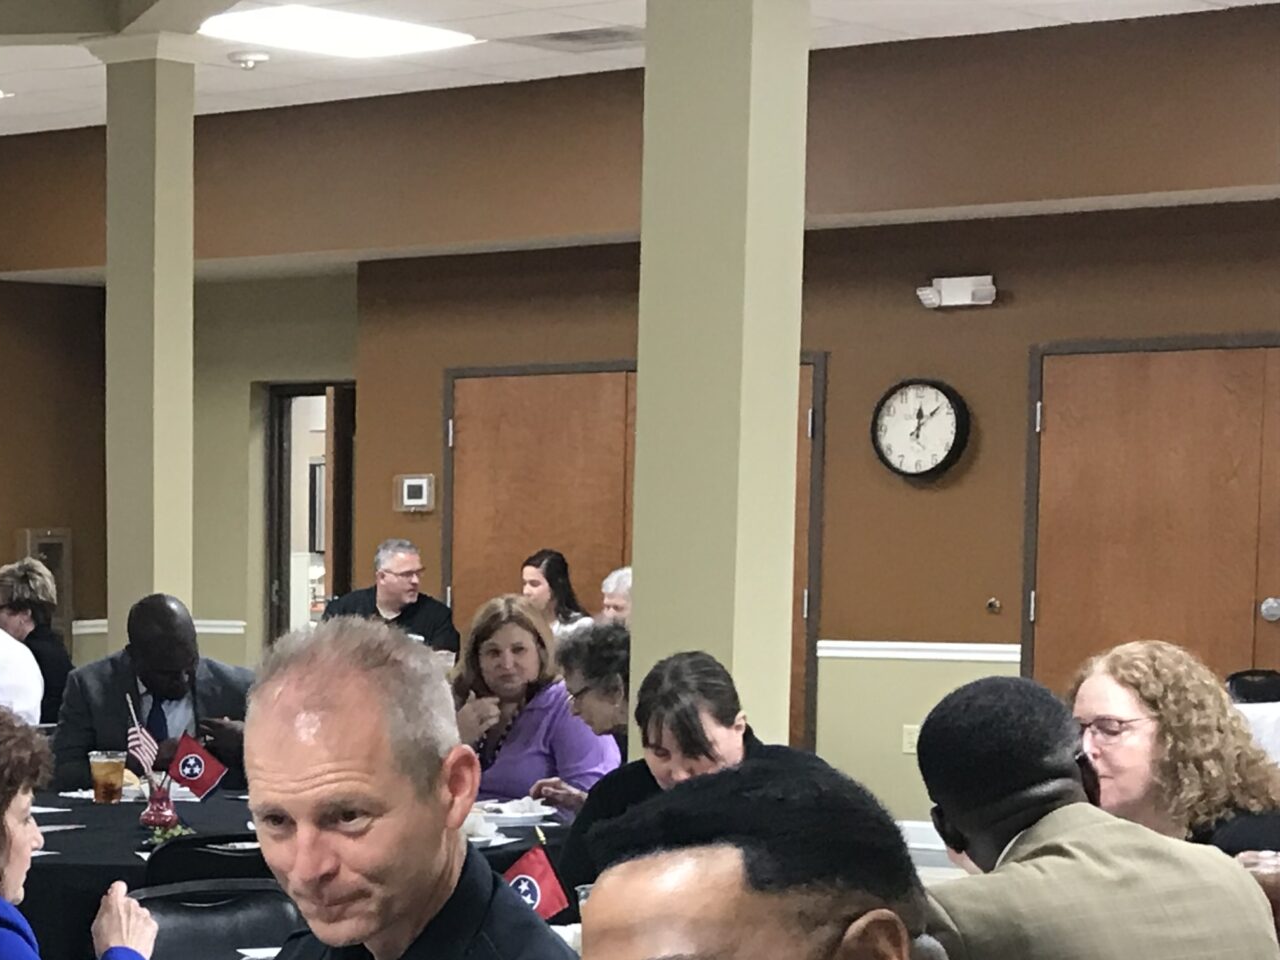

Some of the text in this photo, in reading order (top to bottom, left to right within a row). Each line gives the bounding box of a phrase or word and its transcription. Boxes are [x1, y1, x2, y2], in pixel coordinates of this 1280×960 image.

[900, 389, 909, 404] 11
[880, 424, 888, 437] 9
[885, 443, 893, 456] 8
[898, 453, 905, 467] 7
[931, 453, 938, 466] 5
[915, 460, 922, 473] 6
